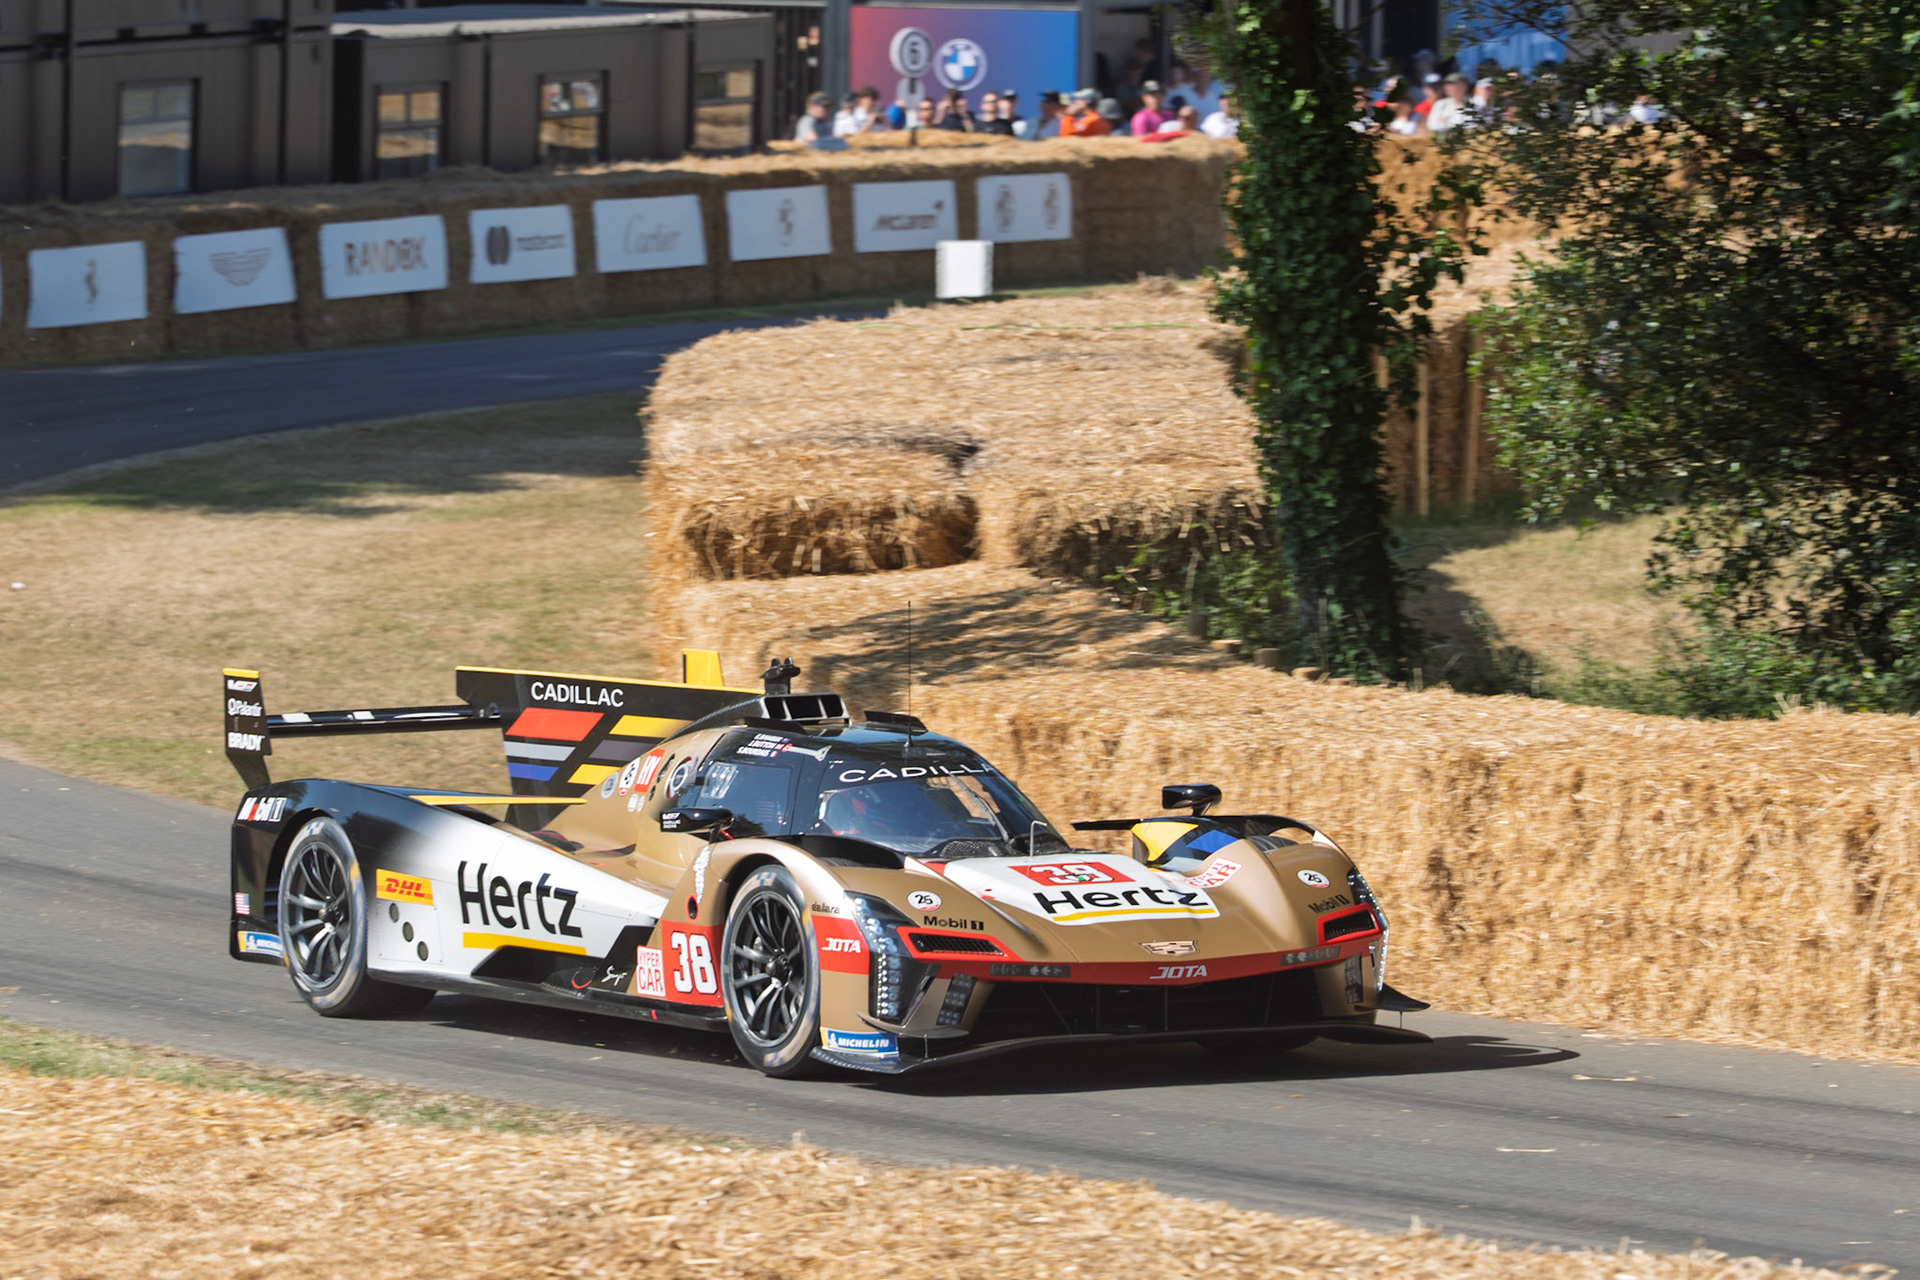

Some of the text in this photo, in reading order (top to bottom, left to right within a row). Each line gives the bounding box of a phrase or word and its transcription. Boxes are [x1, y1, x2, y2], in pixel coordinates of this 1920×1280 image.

[530, 681, 624, 708] CADILLAC
[228, 731, 265, 751] BRADY
[237, 797, 275, 822] Mobil
[385, 877, 428, 898] DHL
[458, 860, 584, 939] Hertz
[811, 901, 840, 914] dallara
[914, 894, 934, 905] 25
[1033, 886, 1208, 915] Hertz
[1307, 896, 1340, 914] Mobil
[923, 915, 984, 931] Mobil 1
[821, 937, 861, 953] JOTA
[670, 931, 718, 995] 38
[1149, 965, 1207, 979] JOTA
[639, 966, 663, 992] CAR
[838, 1037, 890, 1048] MICHELIN
